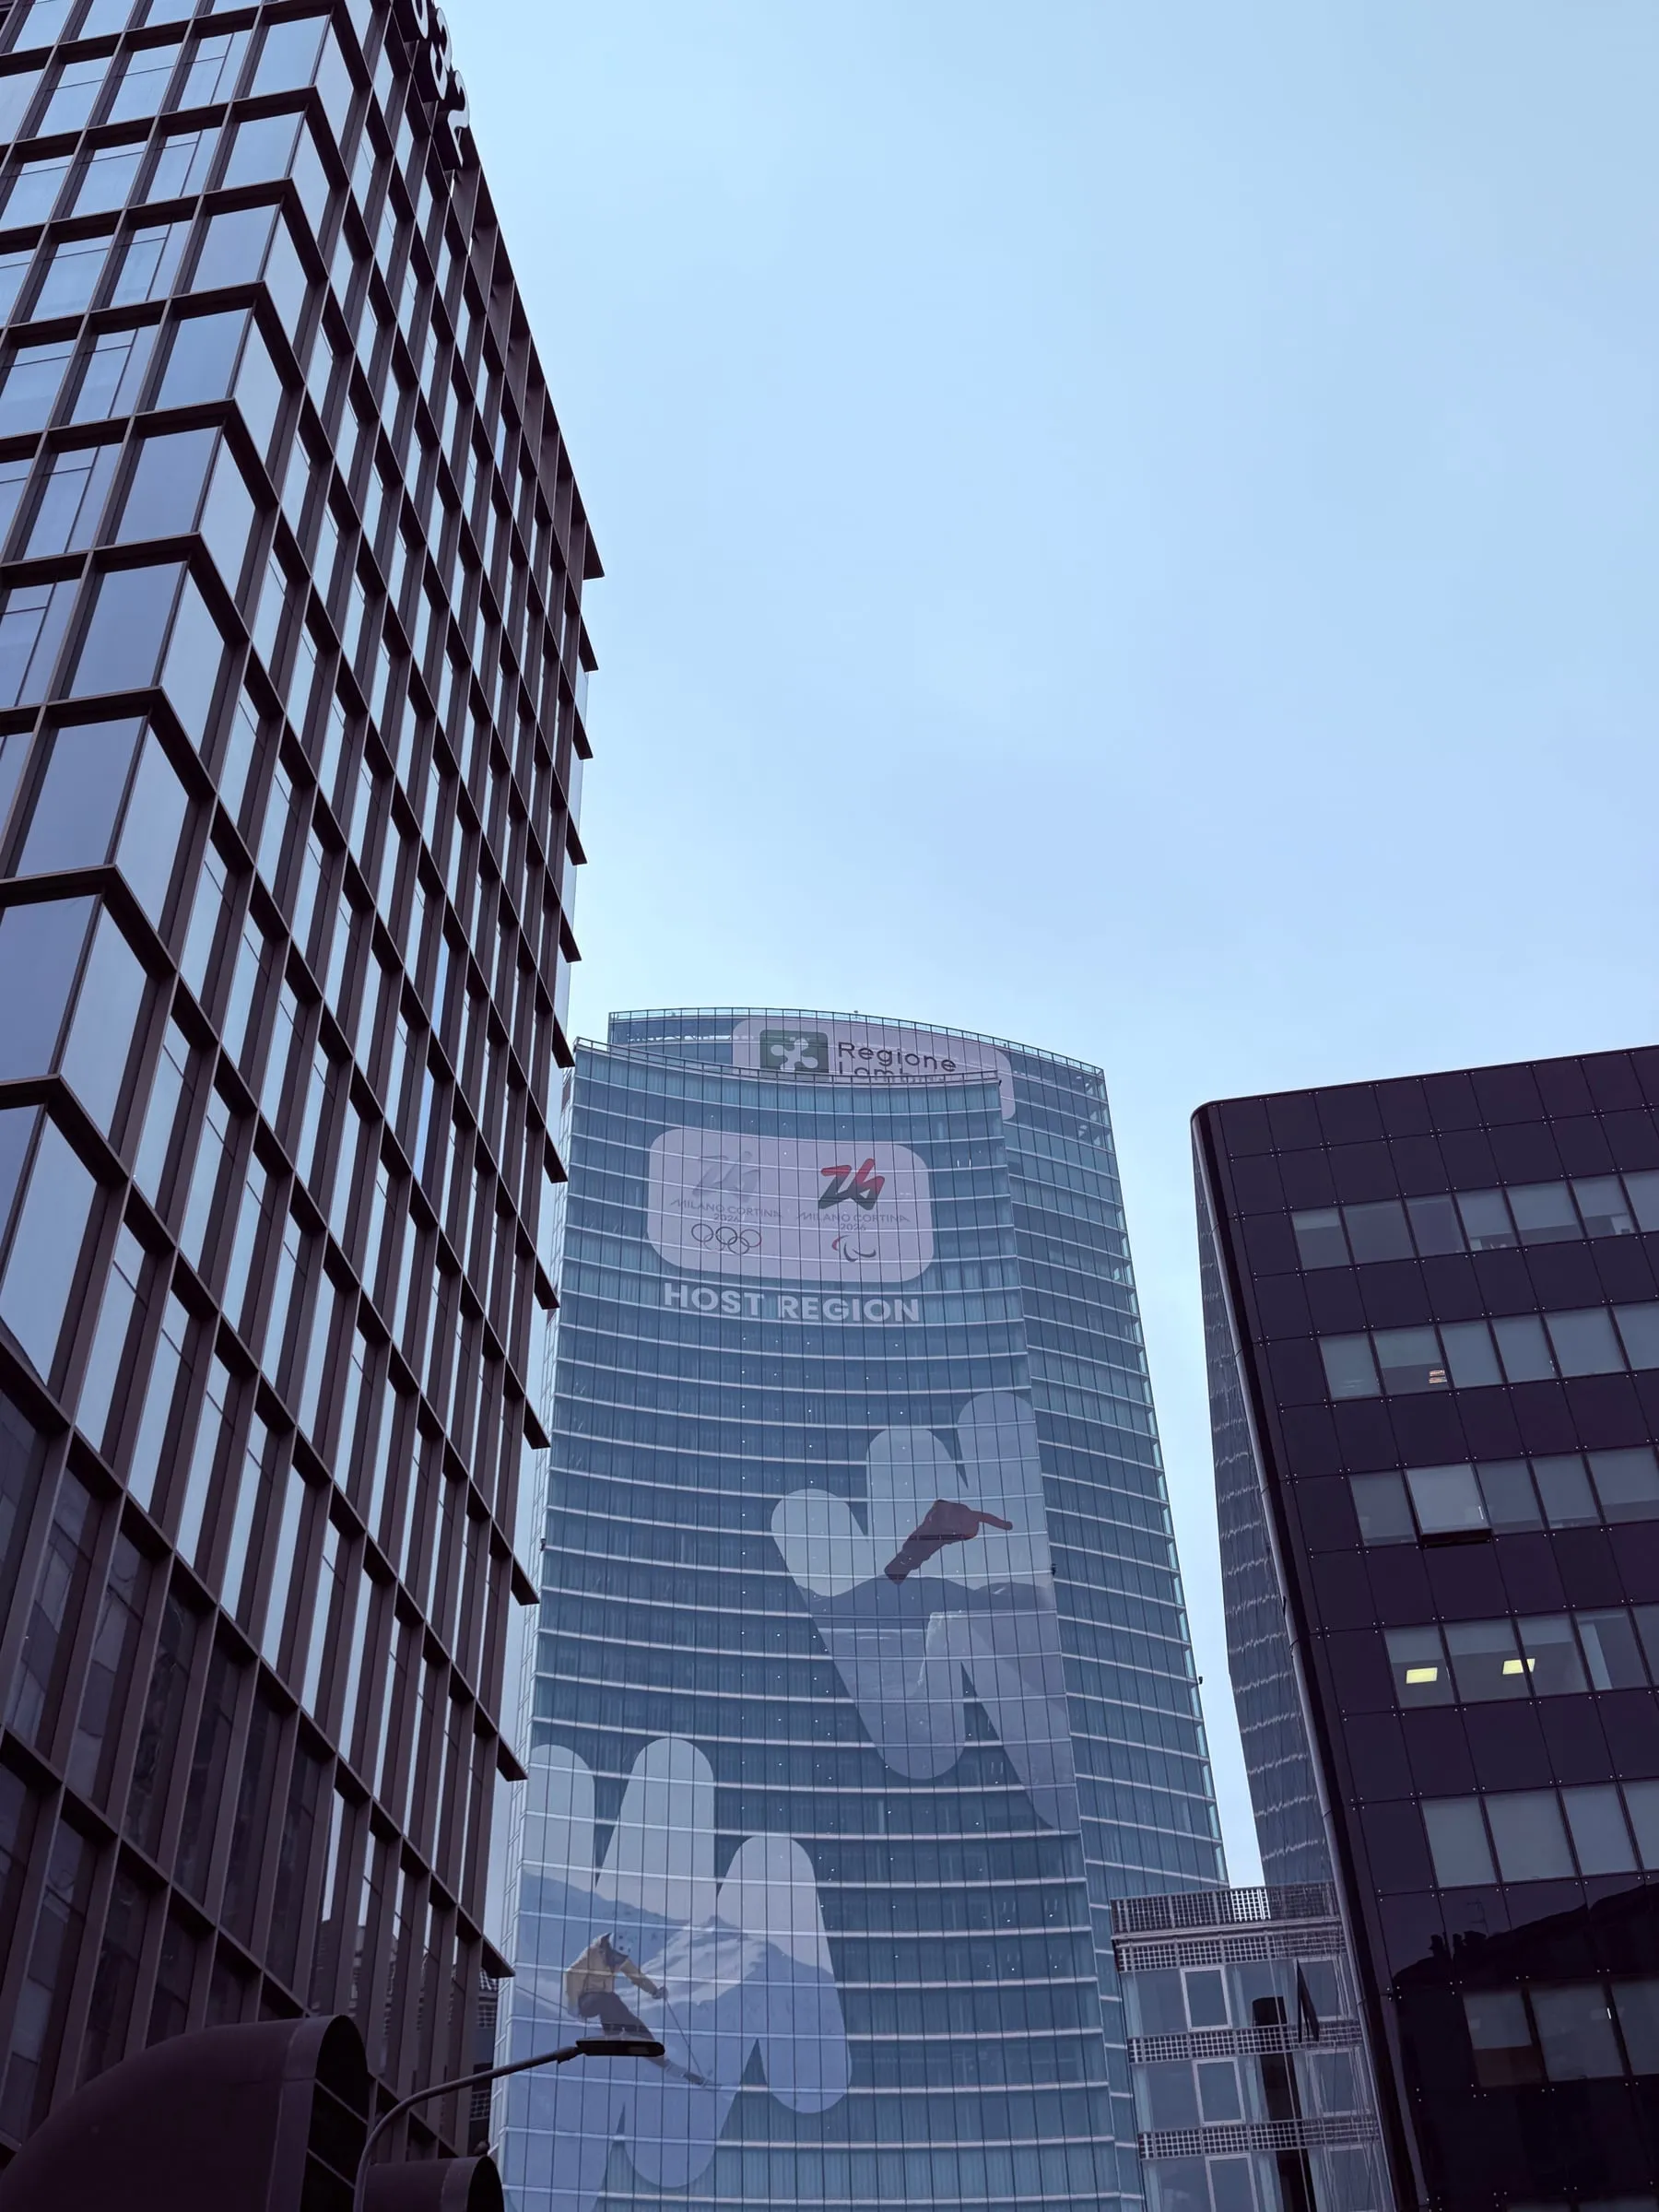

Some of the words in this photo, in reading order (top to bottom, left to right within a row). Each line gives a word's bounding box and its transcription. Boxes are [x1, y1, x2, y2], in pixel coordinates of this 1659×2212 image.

[838, 1041, 957, 1072] Regione
[670, 1198, 725, 1212] MILANO
[727, 1205, 783, 1218] CORTINA
[796, 1210, 850, 1223] MILANO
[853, 1213, 911, 1223] CORTINA
[840, 1222, 867, 1231] 2026
[664, 1282, 764, 1316] HOST
[778, 1294, 919, 1322] REGION
